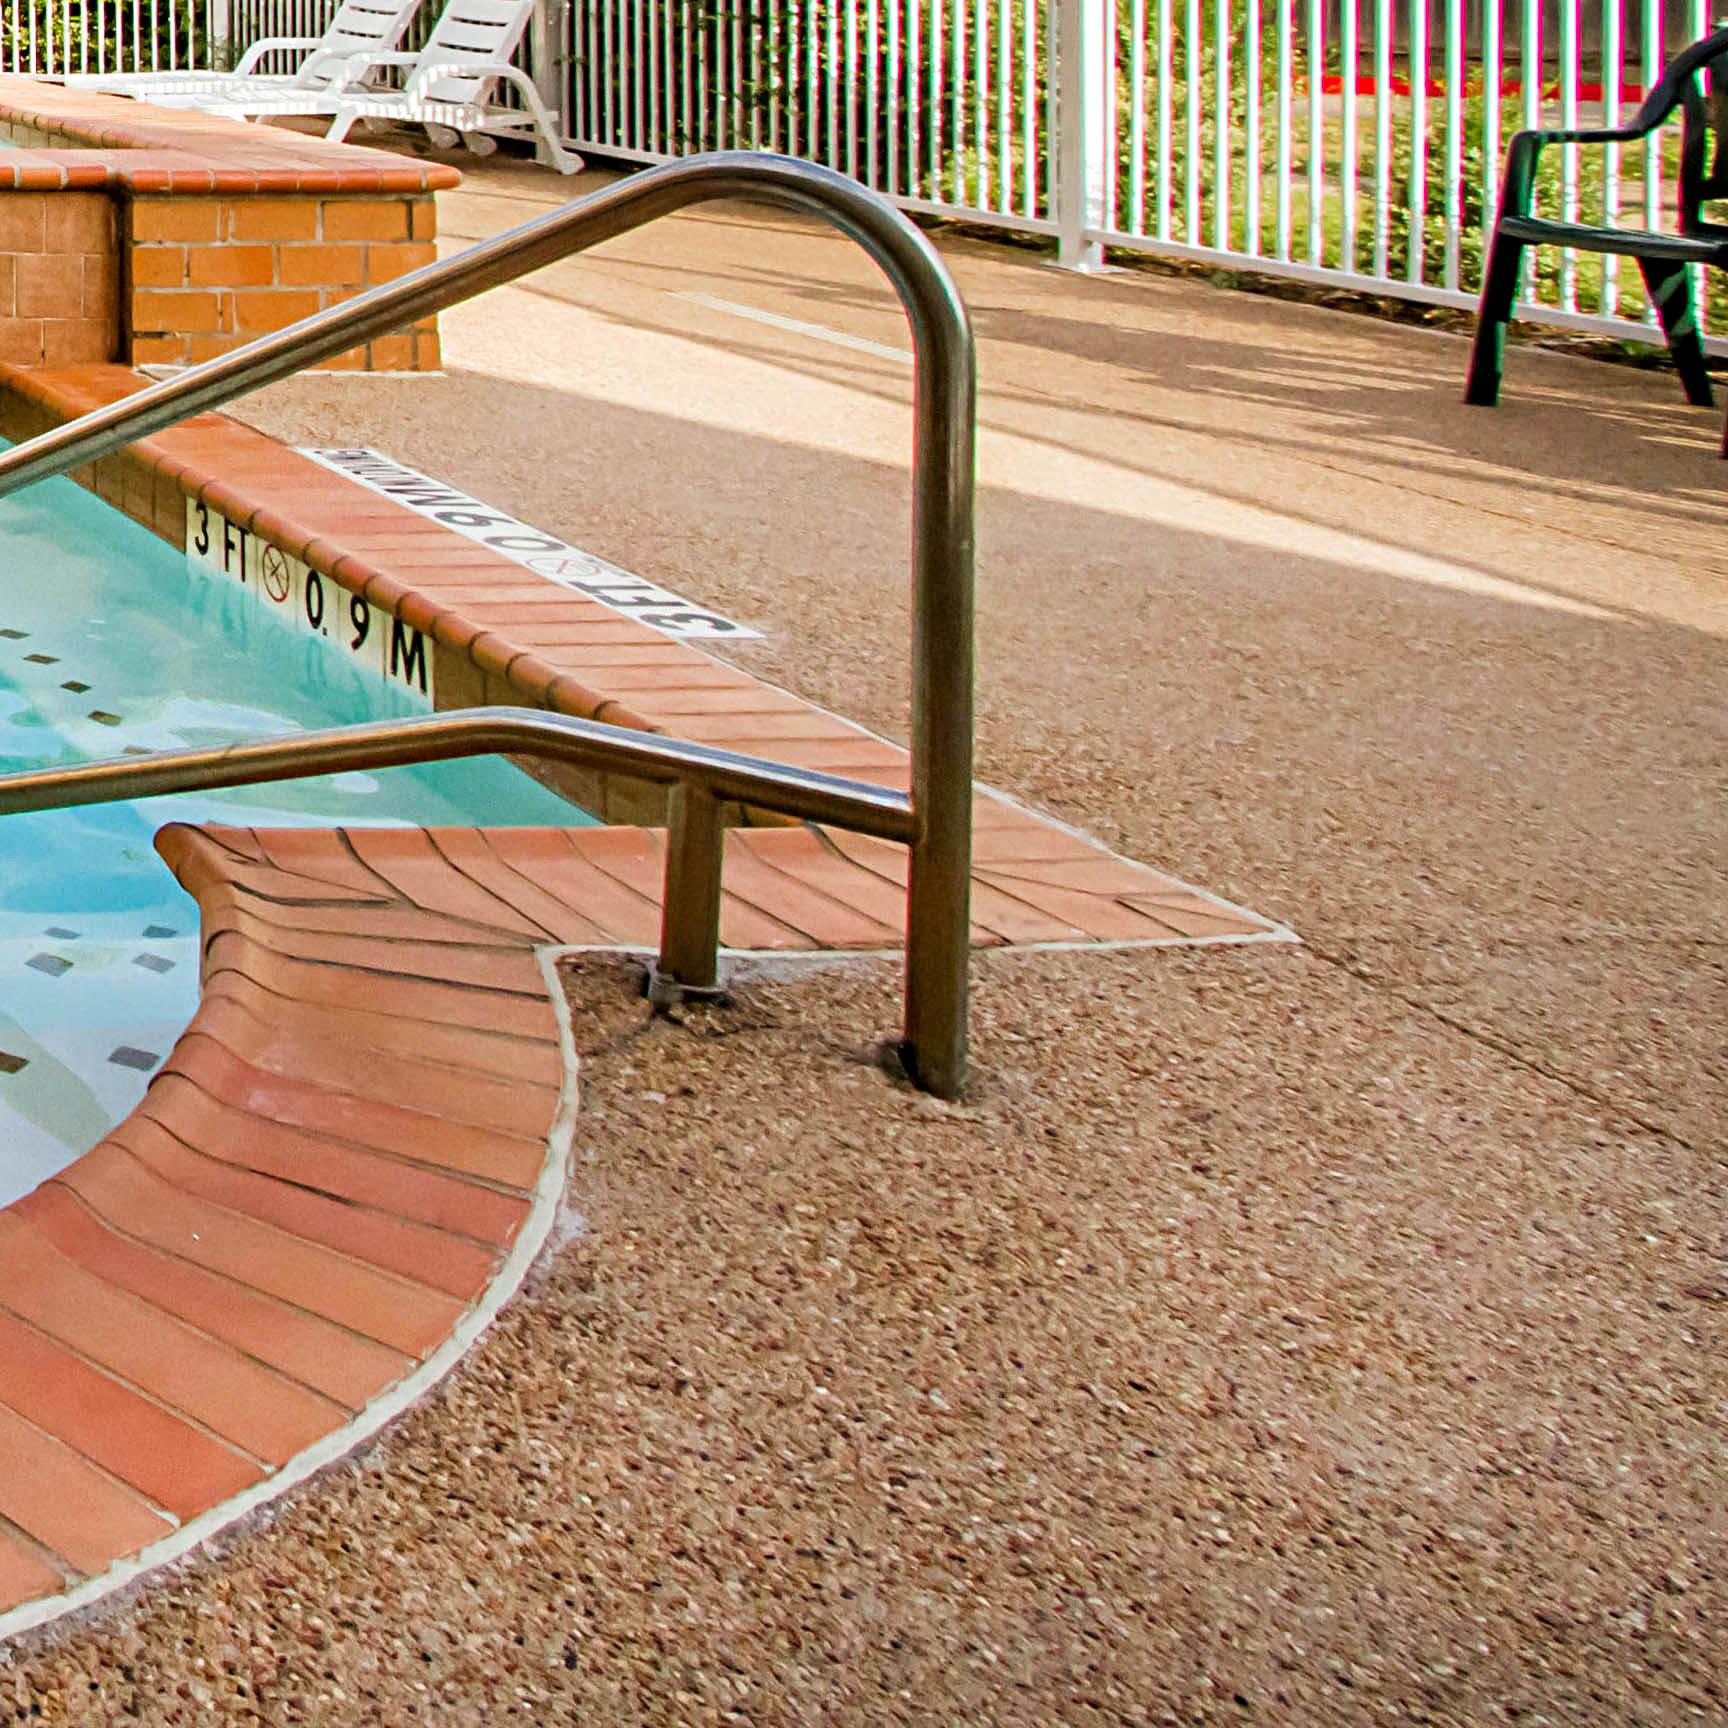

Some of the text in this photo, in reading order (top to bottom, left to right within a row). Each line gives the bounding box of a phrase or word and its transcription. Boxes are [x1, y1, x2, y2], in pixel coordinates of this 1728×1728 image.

[194, 500, 209, 556] 3
[224, 517, 249, 583] FT
[390, 618, 427, 696] M
